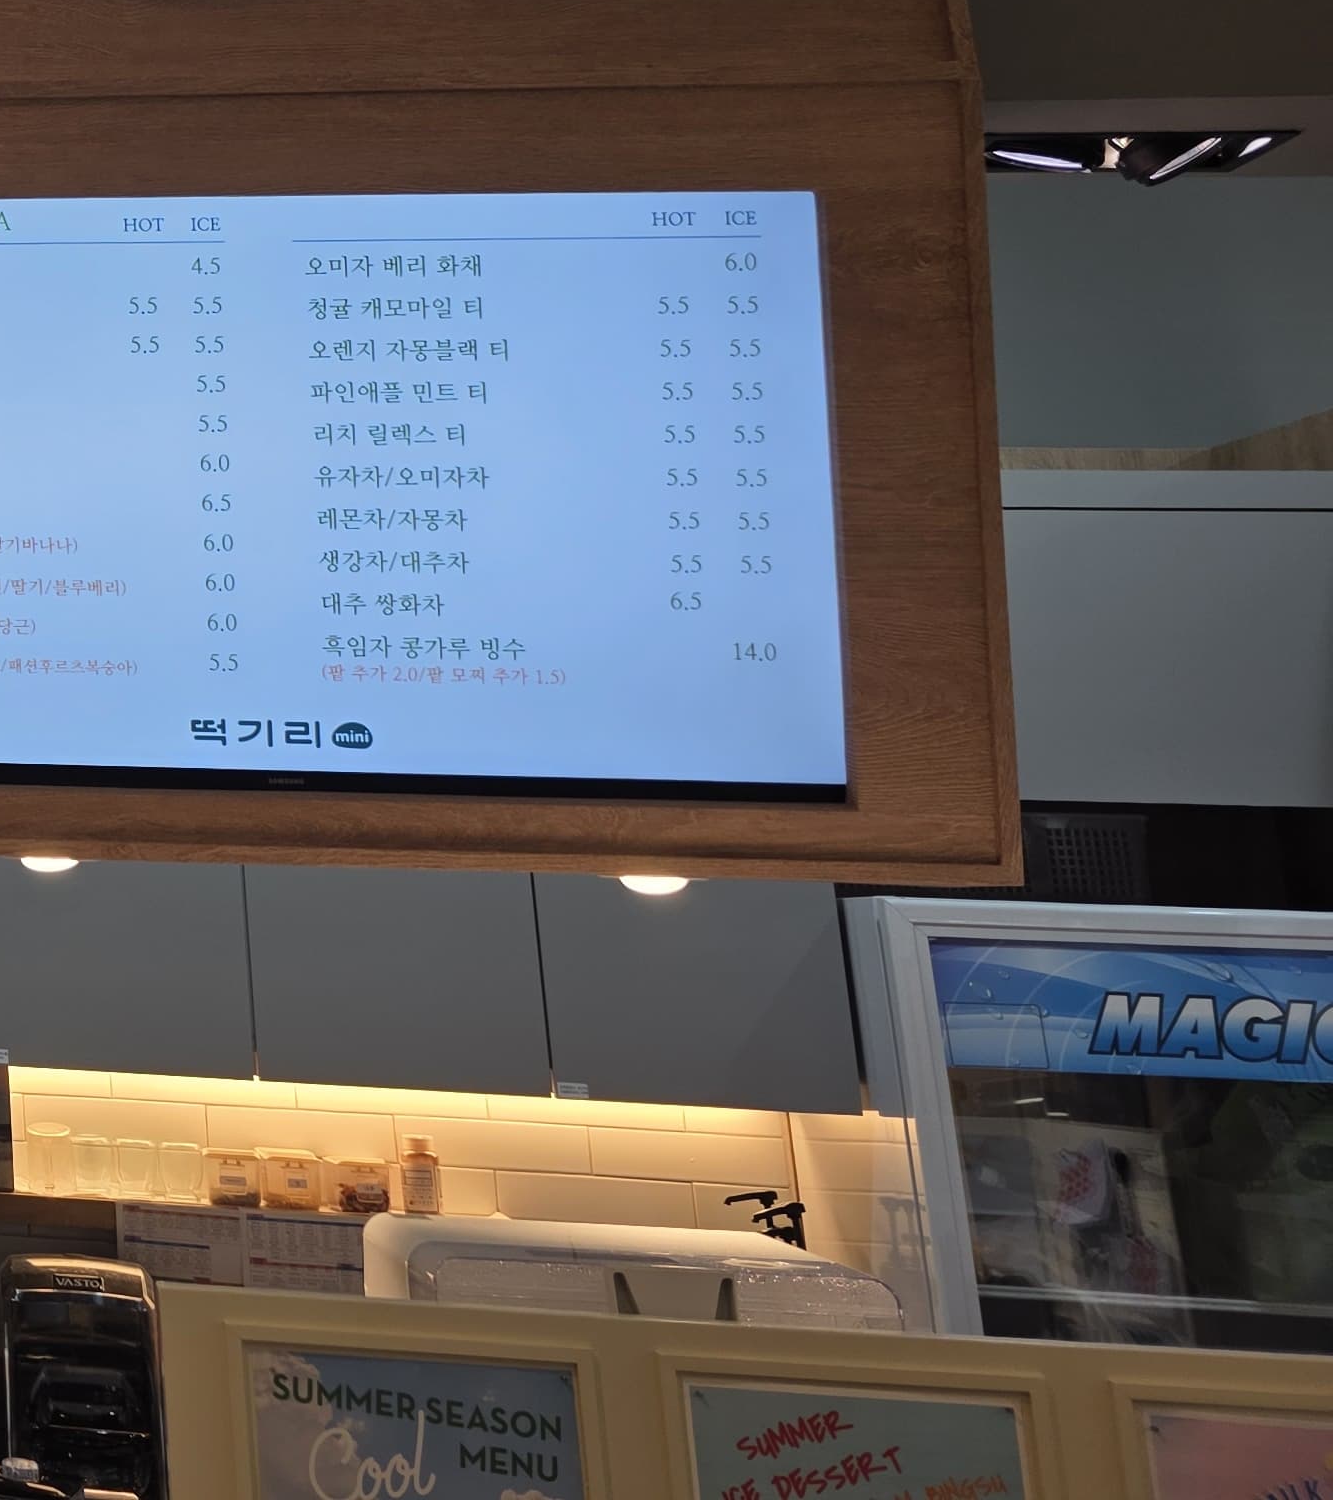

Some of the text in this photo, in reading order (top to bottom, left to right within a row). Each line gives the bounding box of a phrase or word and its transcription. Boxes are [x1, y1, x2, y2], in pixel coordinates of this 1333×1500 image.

[123, 218, 164, 232] HOT
[191, 217, 220, 231] ICE
[652, 211, 757, 226] HOT ICE
[192, 257, 220, 275] 4.5
[305, 253, 756, 277] 오미자 베리 화채 6.0
[129, 297, 157, 314] 5.5
[193, 297, 222, 314] 5.5
[309, 339, 760, 362] 오렌지 자몽블랙 티 5.5 5.5
[315, 466, 766, 489] 유자차/오미자차 5.5 5.5
[202, 494, 230, 512] 6.5
[322, 592, 701, 616] 대추 쌍화차 6.5
[208, 614, 237, 632] 6.0
[322, 635, 776, 661] 흑임자 콩가루 빙수 14.0
[190, 718, 370, 749] 떡기리 mini
[54, 1276, 101, 1289] VASTO
[271, 1373, 563, 1443] SUMMER SEASON
[736, 1410, 854, 1461] SUMMER
[308, 1409, 436, 1500] Cool
[459, 1443, 559, 1483] MENU
[771, 1446, 902, 1499] DESSERT
